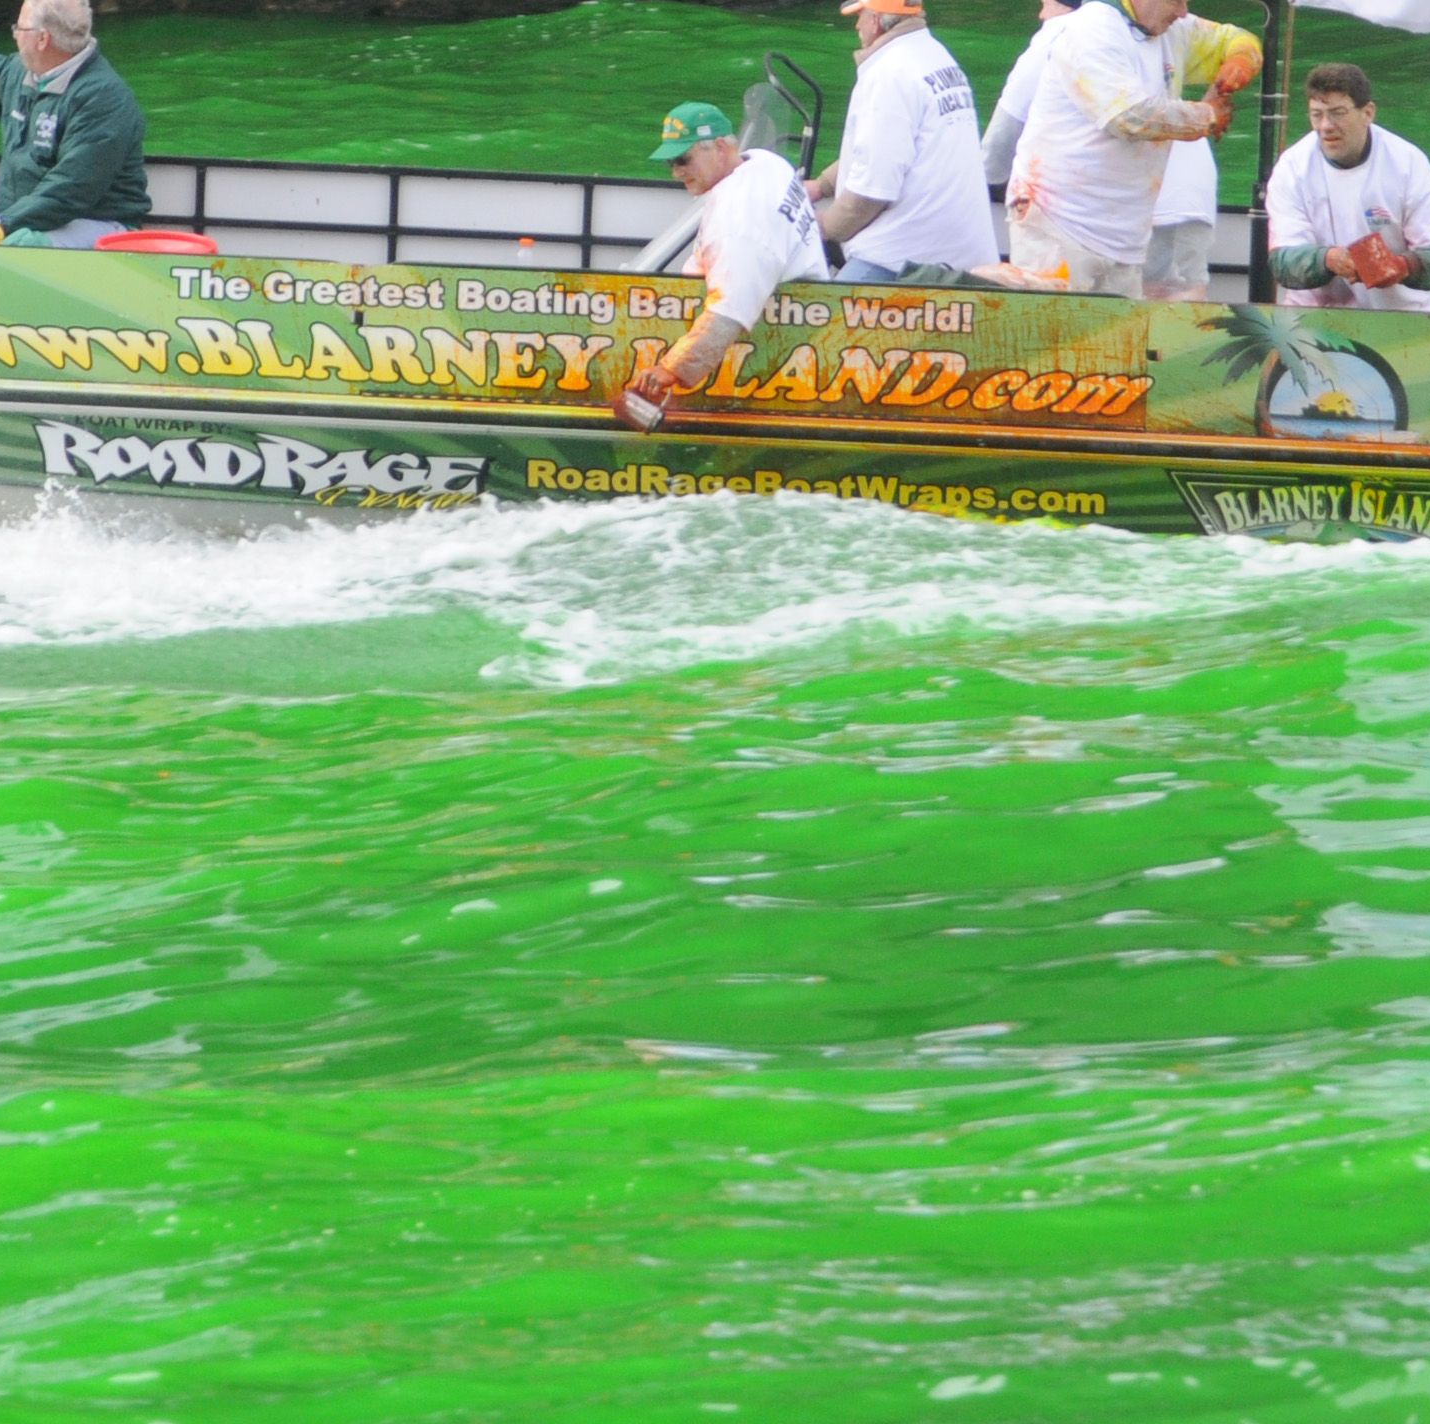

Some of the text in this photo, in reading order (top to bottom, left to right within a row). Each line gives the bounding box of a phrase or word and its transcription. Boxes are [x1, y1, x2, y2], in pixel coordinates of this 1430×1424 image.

[171, 266, 974, 334] The Greatest Boating Bar the World!
[134, 417, 195, 432] WRAP
[526, 458, 1106, 515] RoadRageBoatWraps.com
[1214, 484, 1345, 532] BLARNEY
